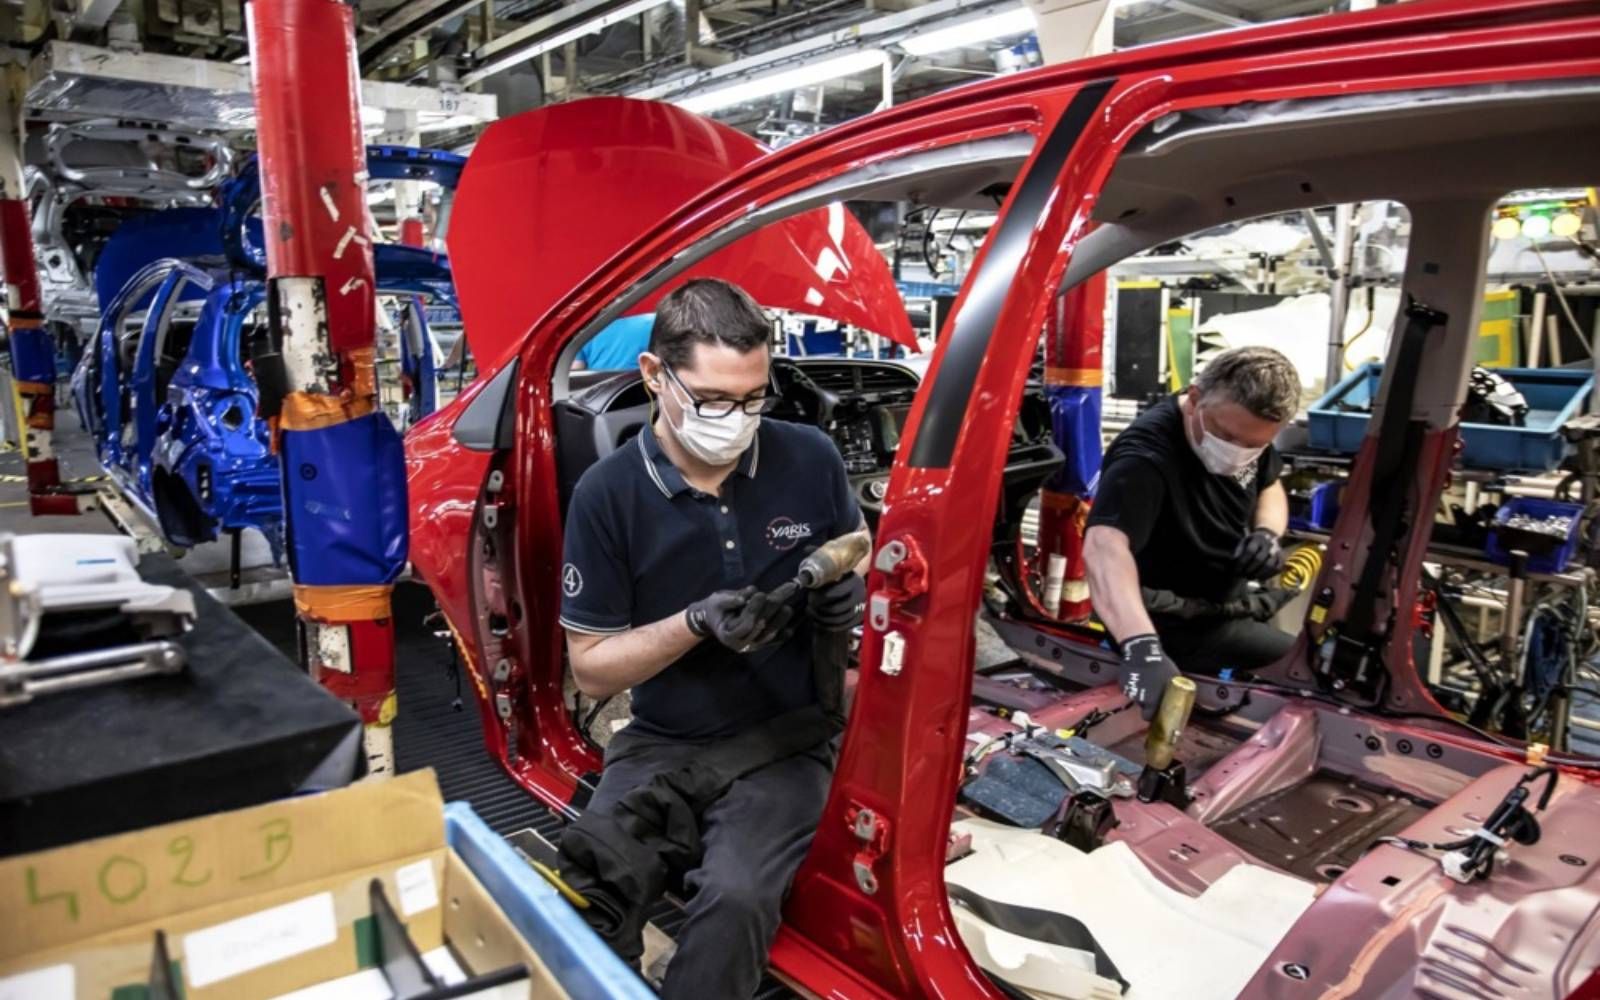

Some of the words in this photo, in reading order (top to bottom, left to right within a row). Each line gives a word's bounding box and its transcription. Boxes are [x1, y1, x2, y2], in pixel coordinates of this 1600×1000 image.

[771, 522, 812, 539] YARIS
[563, 566, 577, 592] 4
[25, 836, 213, 922] 402
